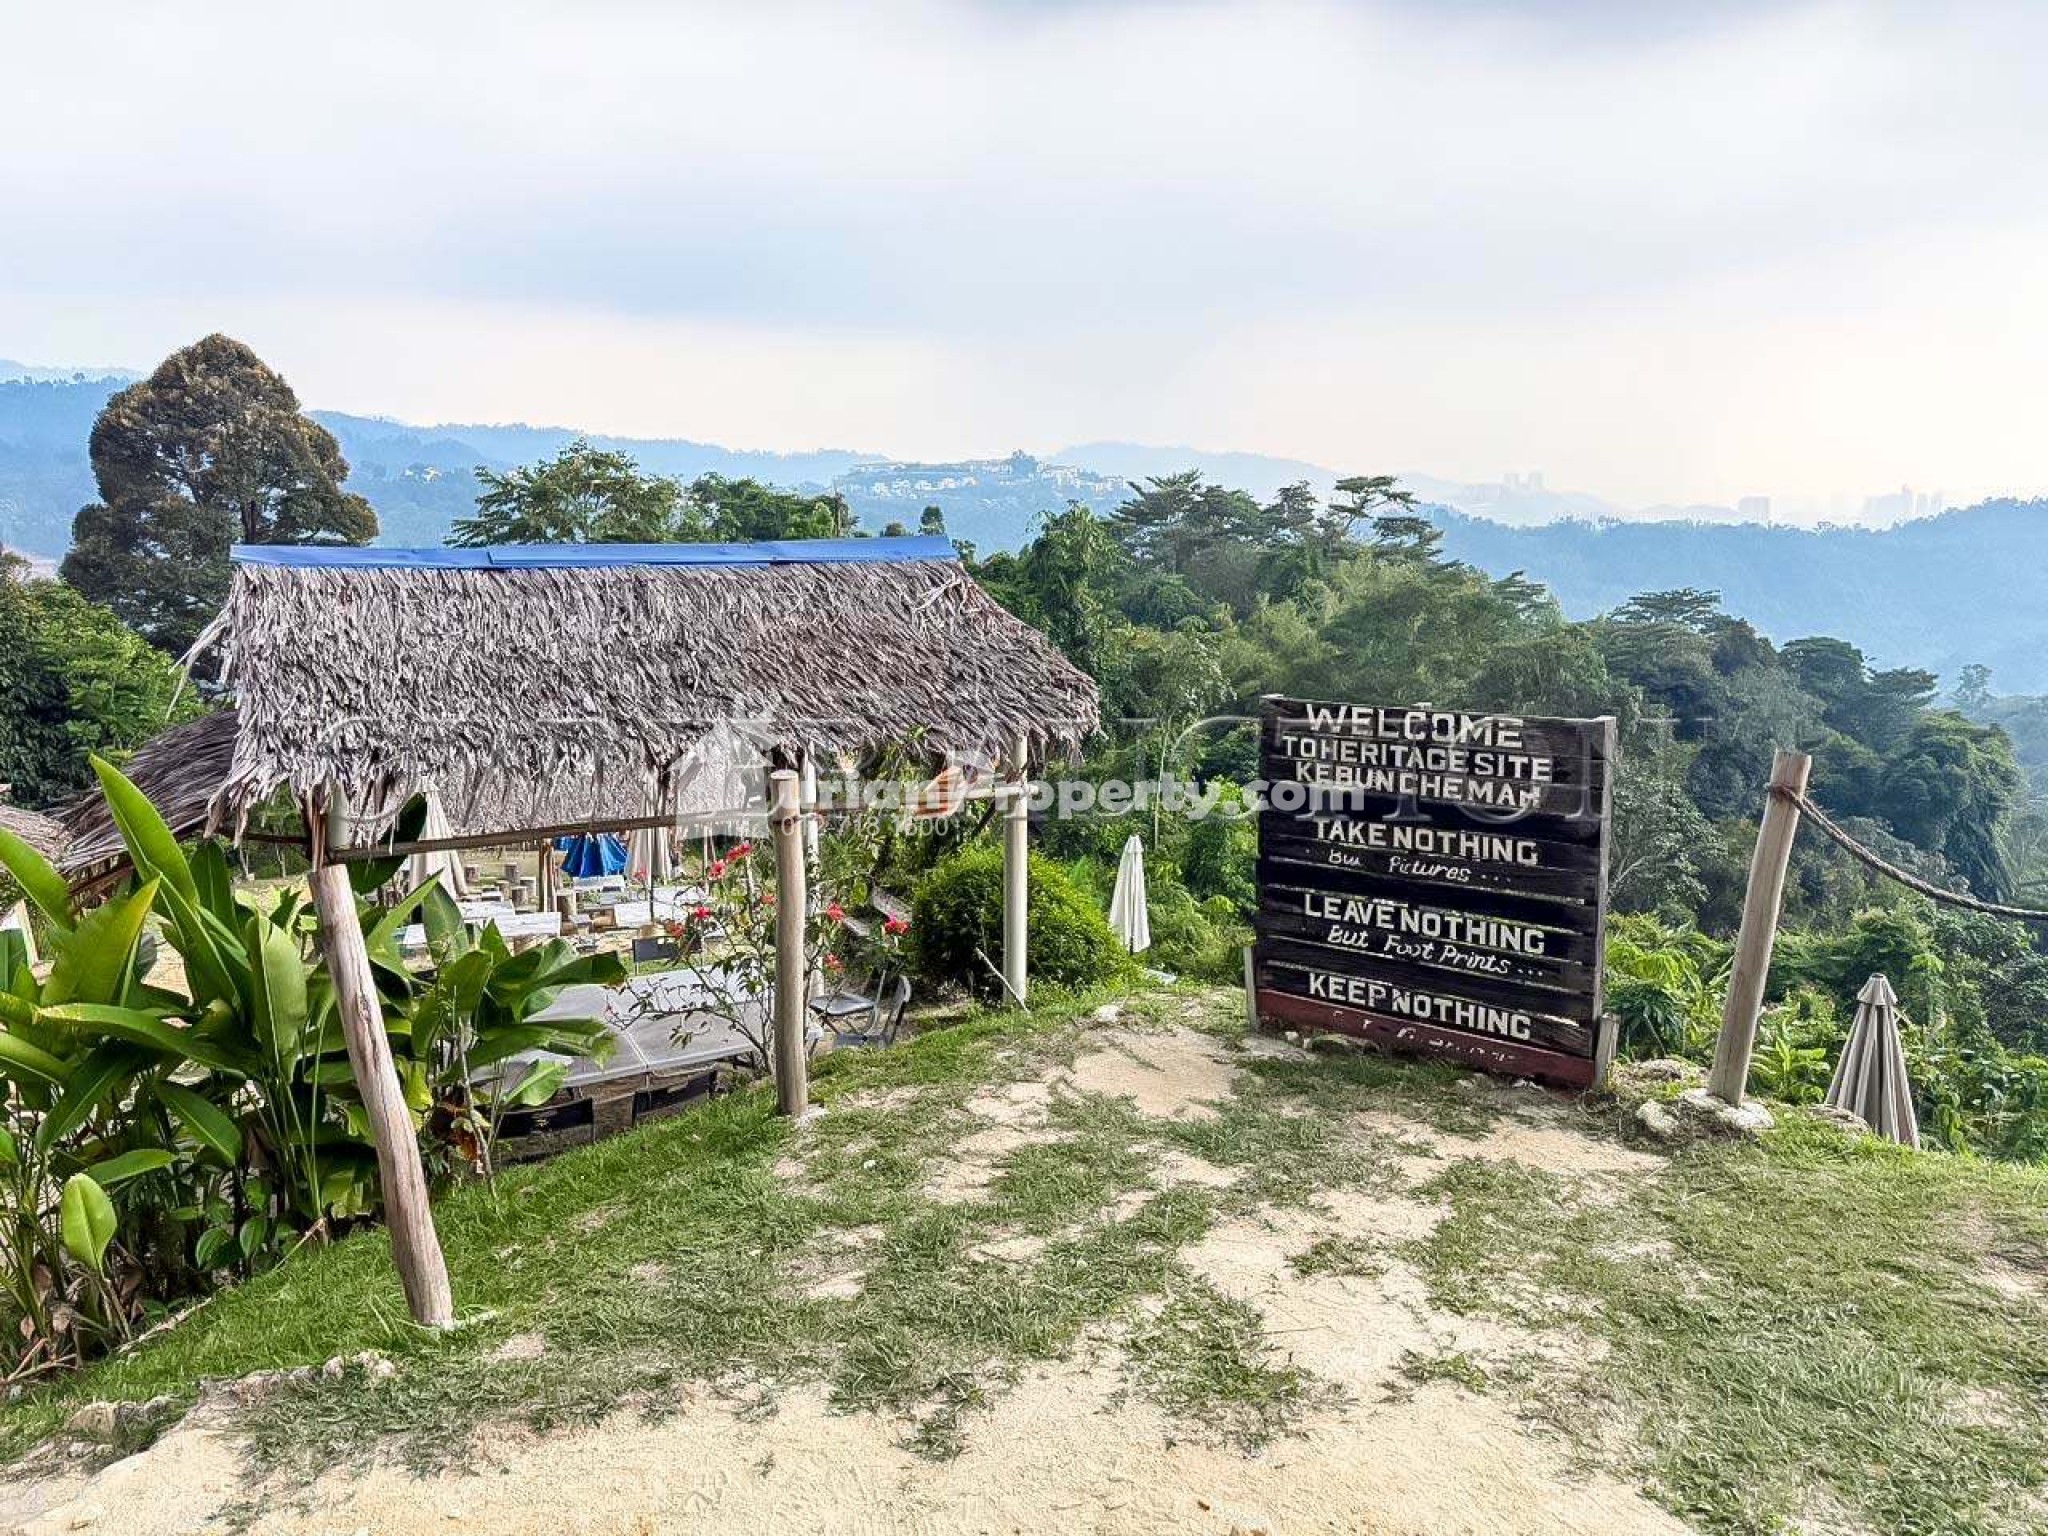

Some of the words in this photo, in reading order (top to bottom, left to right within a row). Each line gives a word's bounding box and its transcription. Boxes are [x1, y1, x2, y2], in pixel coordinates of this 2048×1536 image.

[1306, 703, 1524, 748] WELCOME
[1474, 752, 1552, 782] SITE
[1314, 818, 1387, 846] TAKE
[1393, 826, 1538, 867] NOTHING
[1304, 893, 1395, 930] LEAVE
[1401, 908, 1545, 954] NOTHING
[1328, 925, 1369, 948] But
[1383, 934, 1435, 960] Foot
[1309, 972, 1387, 1008] KEEP
[1391, 989, 1531, 1041] NOTHING
